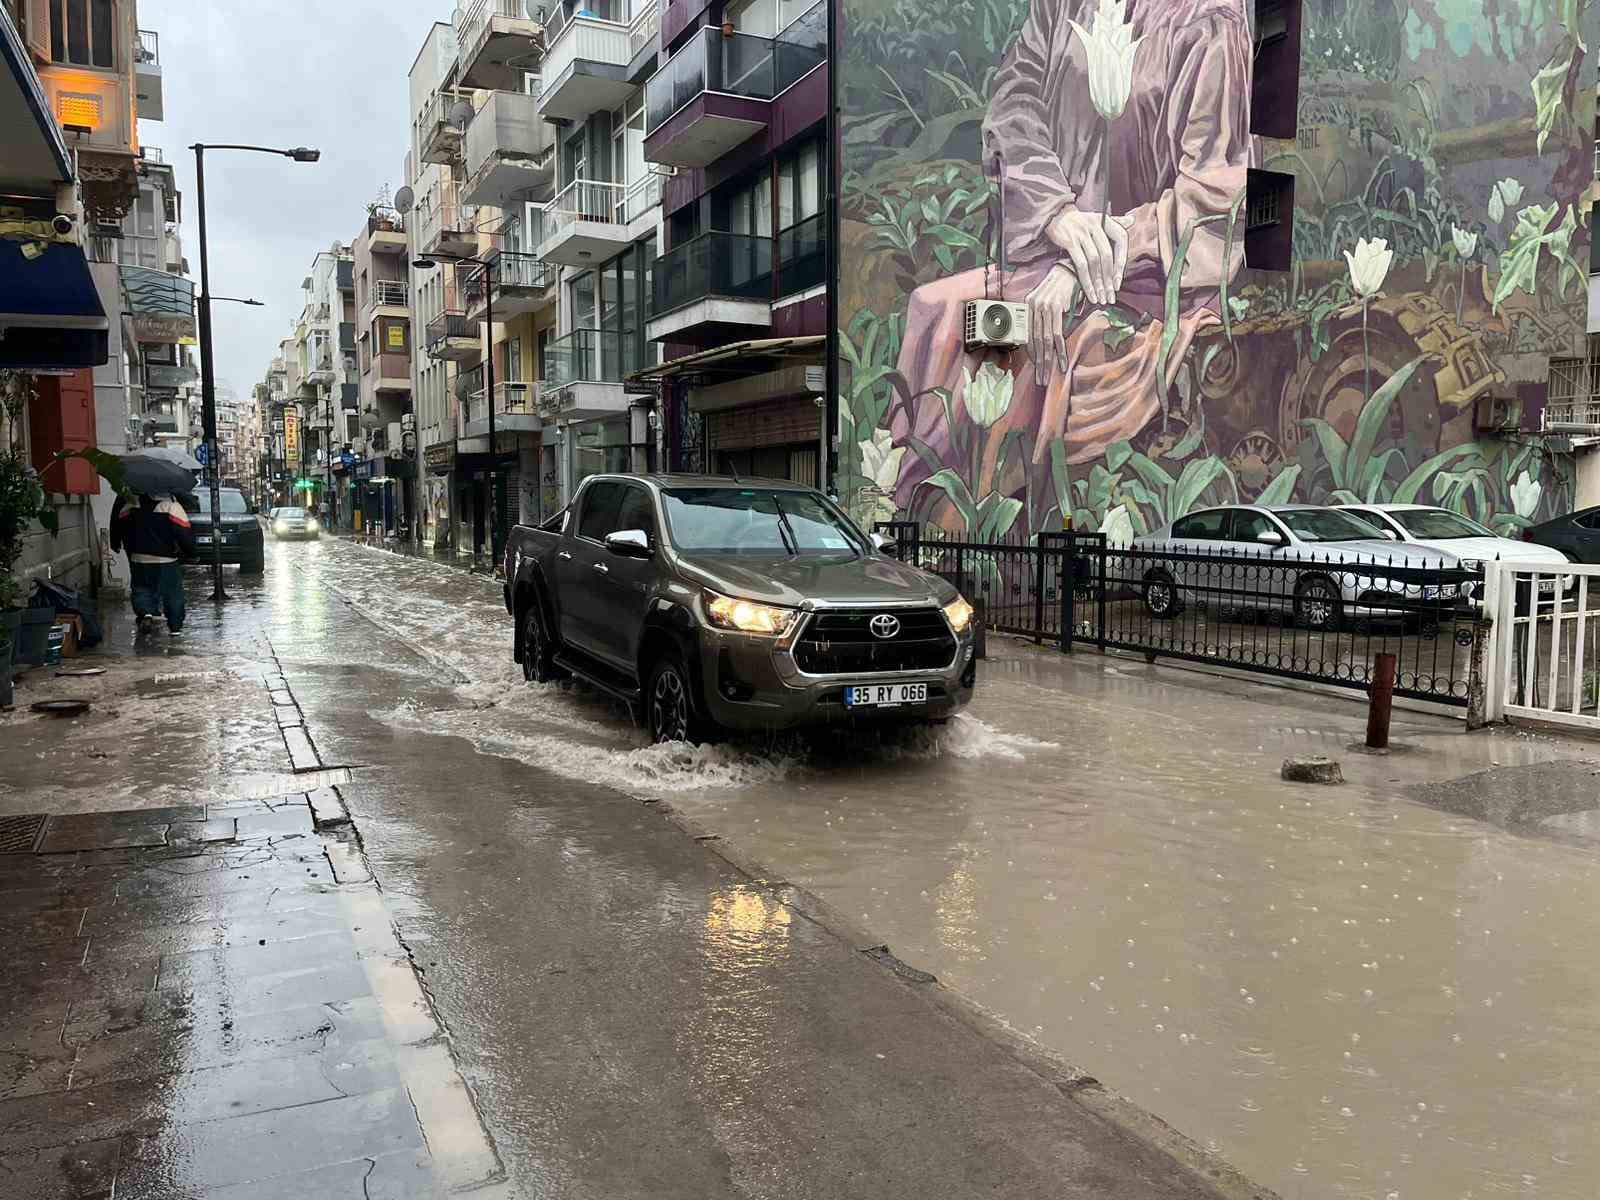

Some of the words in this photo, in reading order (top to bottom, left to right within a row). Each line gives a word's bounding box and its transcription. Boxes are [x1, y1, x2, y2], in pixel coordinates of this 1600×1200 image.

[854, 688, 870, 703] 35
[877, 687, 893, 701] RY
[901, 685, 925, 700] 066
